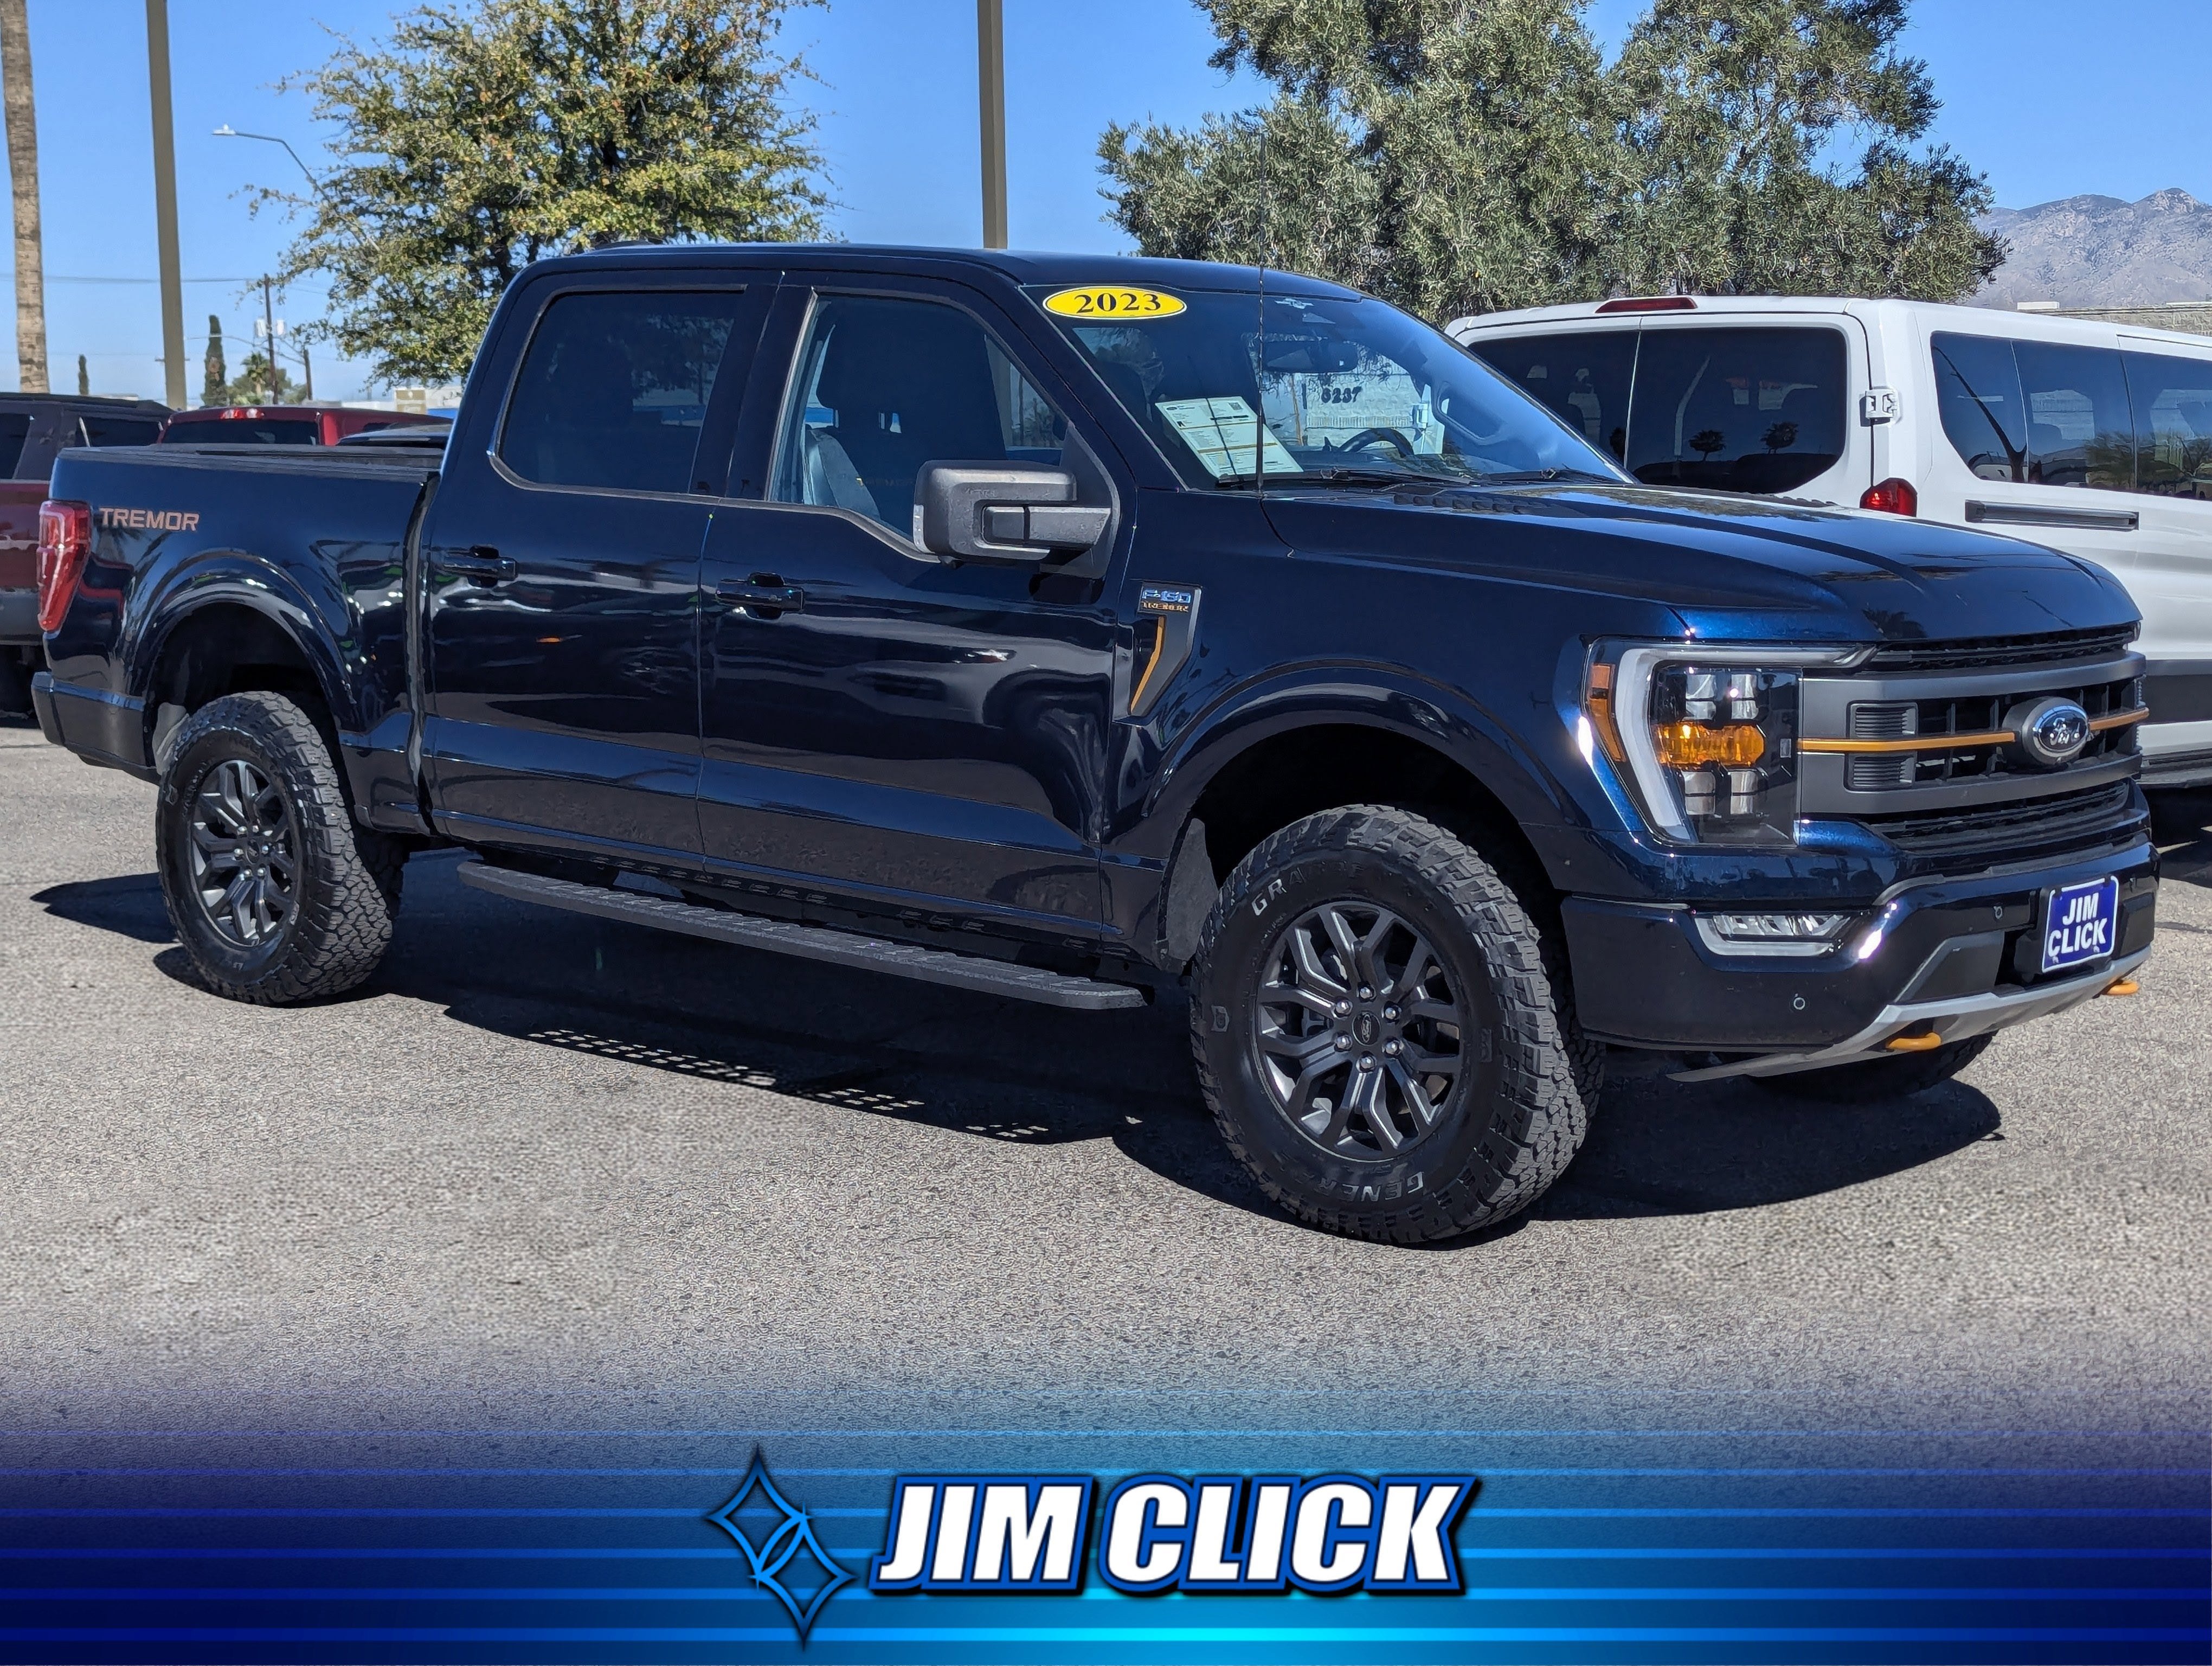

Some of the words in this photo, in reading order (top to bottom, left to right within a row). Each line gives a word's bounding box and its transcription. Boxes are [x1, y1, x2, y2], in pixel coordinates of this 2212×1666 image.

[1074, 292, 1161, 314] 2023
[99, 507, 200, 531] TREMOR
[2062, 892, 2099, 925] JIM
[2048, 918, 2107, 957] CLICK
